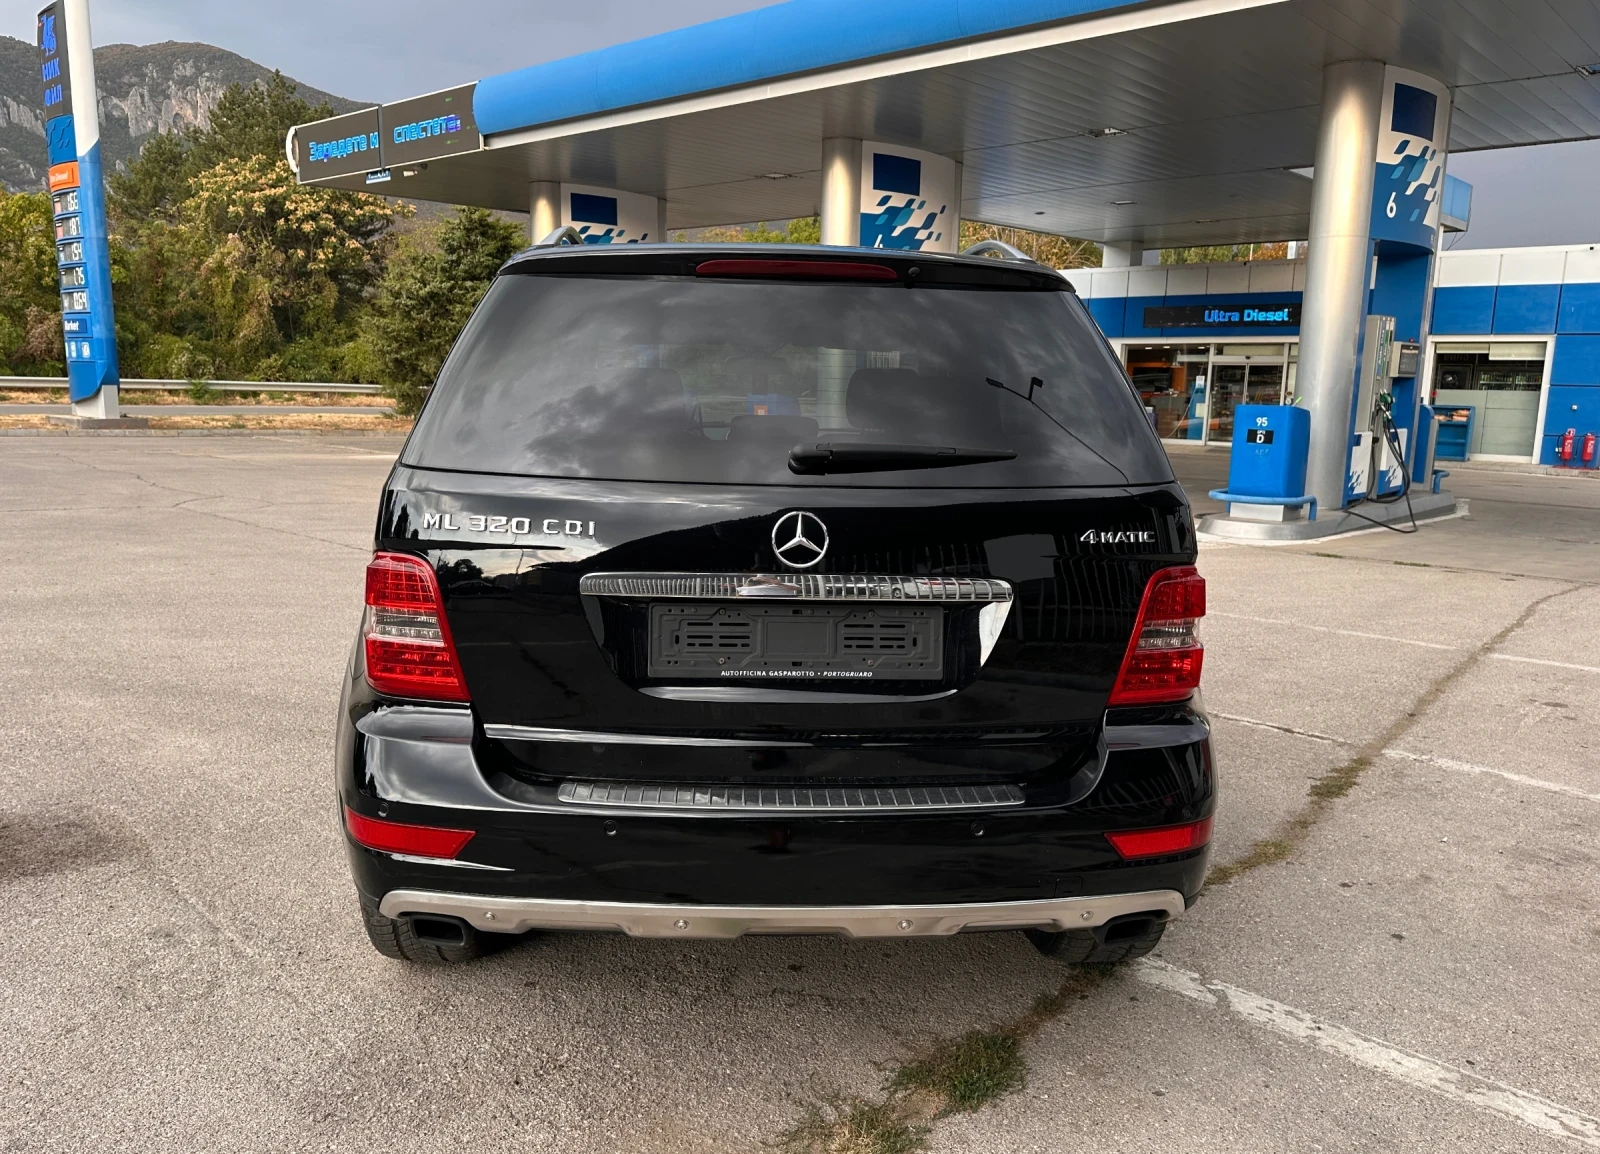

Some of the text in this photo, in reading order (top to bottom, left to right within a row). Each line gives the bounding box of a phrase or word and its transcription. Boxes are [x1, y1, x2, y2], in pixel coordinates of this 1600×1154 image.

[370, 131, 379, 149] и
[1386, 191, 1397, 219] 6
[1204, 308, 1289, 322] Ultra Diesel
[1256, 416, 1268, 427] 95
[1256, 434, 1265, 443] D
[423, 512, 596, 536] ML 320 CDI
